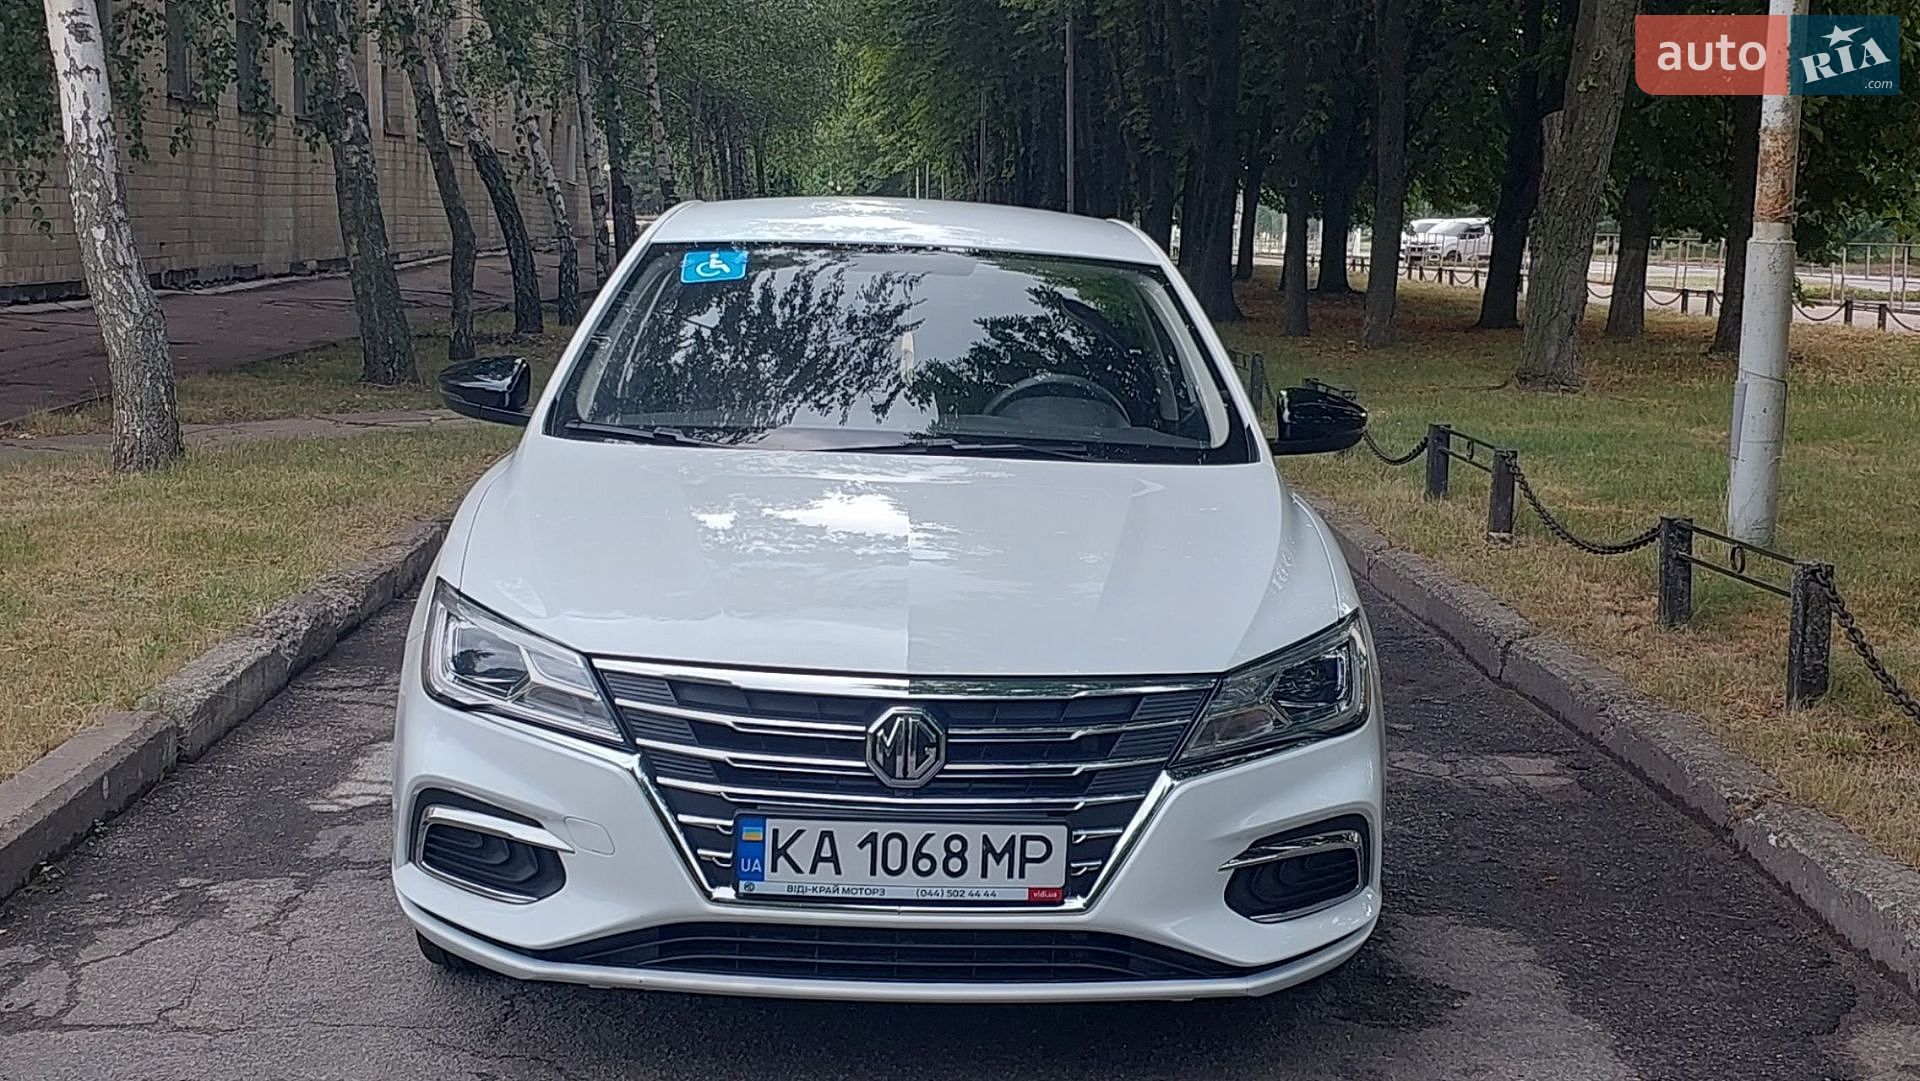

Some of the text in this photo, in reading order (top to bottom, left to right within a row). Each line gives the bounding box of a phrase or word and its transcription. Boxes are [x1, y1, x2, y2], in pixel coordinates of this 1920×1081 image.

[876, 716, 937, 779] MG
[769, 827, 1054, 880] KA 1068 MP
[741, 857, 762, 873] UA
[841, 885, 886, 897] МОТОРЗ
[915, 888, 997, 899] (044) 502 44 44
[1032, 889, 1058, 899] vidi.ua
